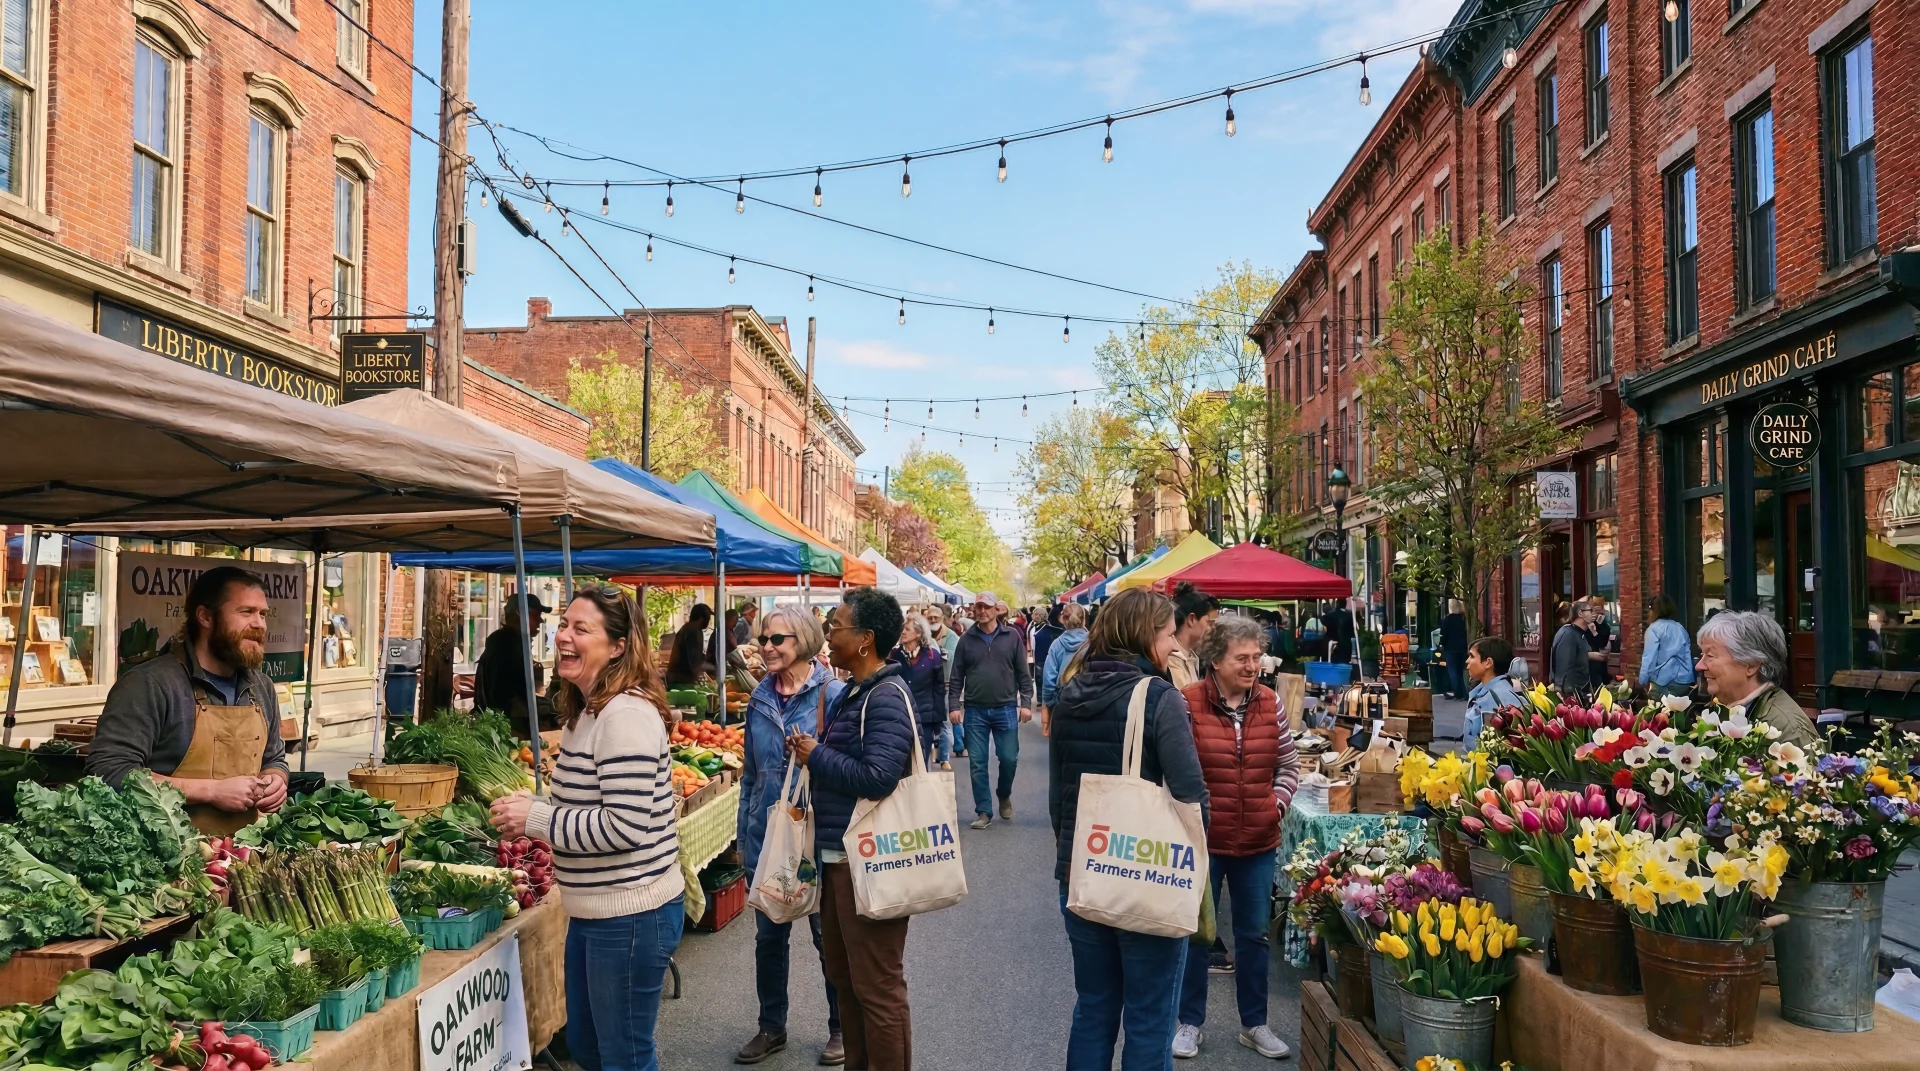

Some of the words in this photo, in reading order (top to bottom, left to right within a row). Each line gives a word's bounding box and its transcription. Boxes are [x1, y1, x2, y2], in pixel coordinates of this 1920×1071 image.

[142, 319, 237, 376] LIBERTY
[242, 355, 340, 408] BOOKSTOR
[354, 353, 412, 368] LIBERTY
[1701, 370, 1739, 405] DAILY
[1743, 353, 1790, 388] GRIND
[1794, 330, 1837, 369] CAFÉ
[345, 370, 420, 384] BOOKSTORE
[1762, 415, 1809, 428] DAILY
[1760, 430, 1812, 444] GRIND
[1769, 447, 1804, 459] CAFE
[131, 565, 204, 596] OAKW
[259, 573, 298, 600] ARM
[864, 858, 913, 874] Farmers
[915, 849, 956, 866] Market
[1085, 858, 1142, 881] Farmers
[1144, 869, 1193, 889] Market
[430, 967, 510, 1056] OAKWOOD
[456, 1017, 495, 1071] FARM
